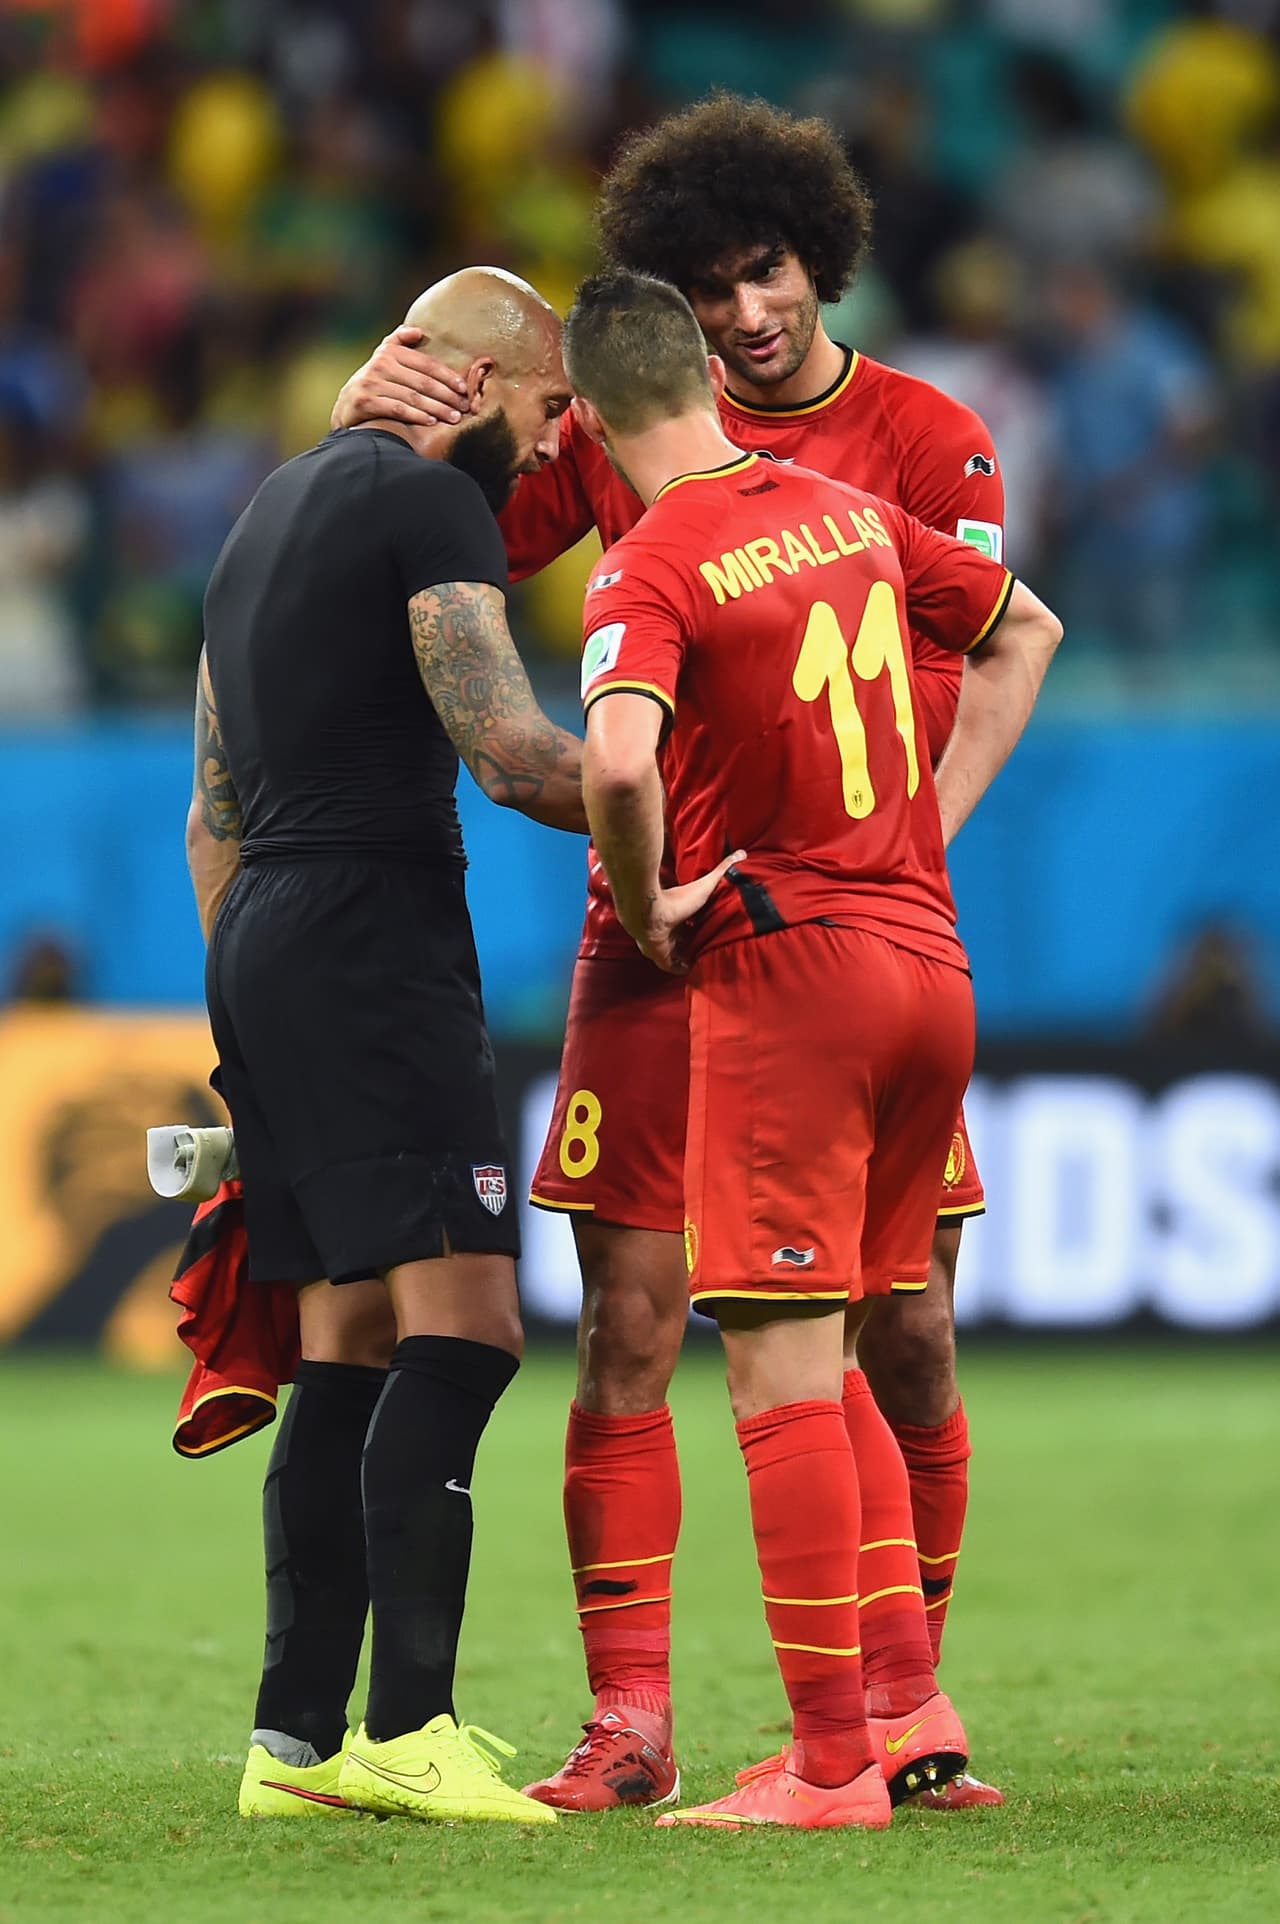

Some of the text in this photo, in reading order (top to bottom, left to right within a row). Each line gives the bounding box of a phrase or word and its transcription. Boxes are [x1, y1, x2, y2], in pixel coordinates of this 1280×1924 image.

[698, 507, 892, 606] MIRALLAS
[793, 580, 920, 820] 11
[559, 1090, 602, 1179] 8
